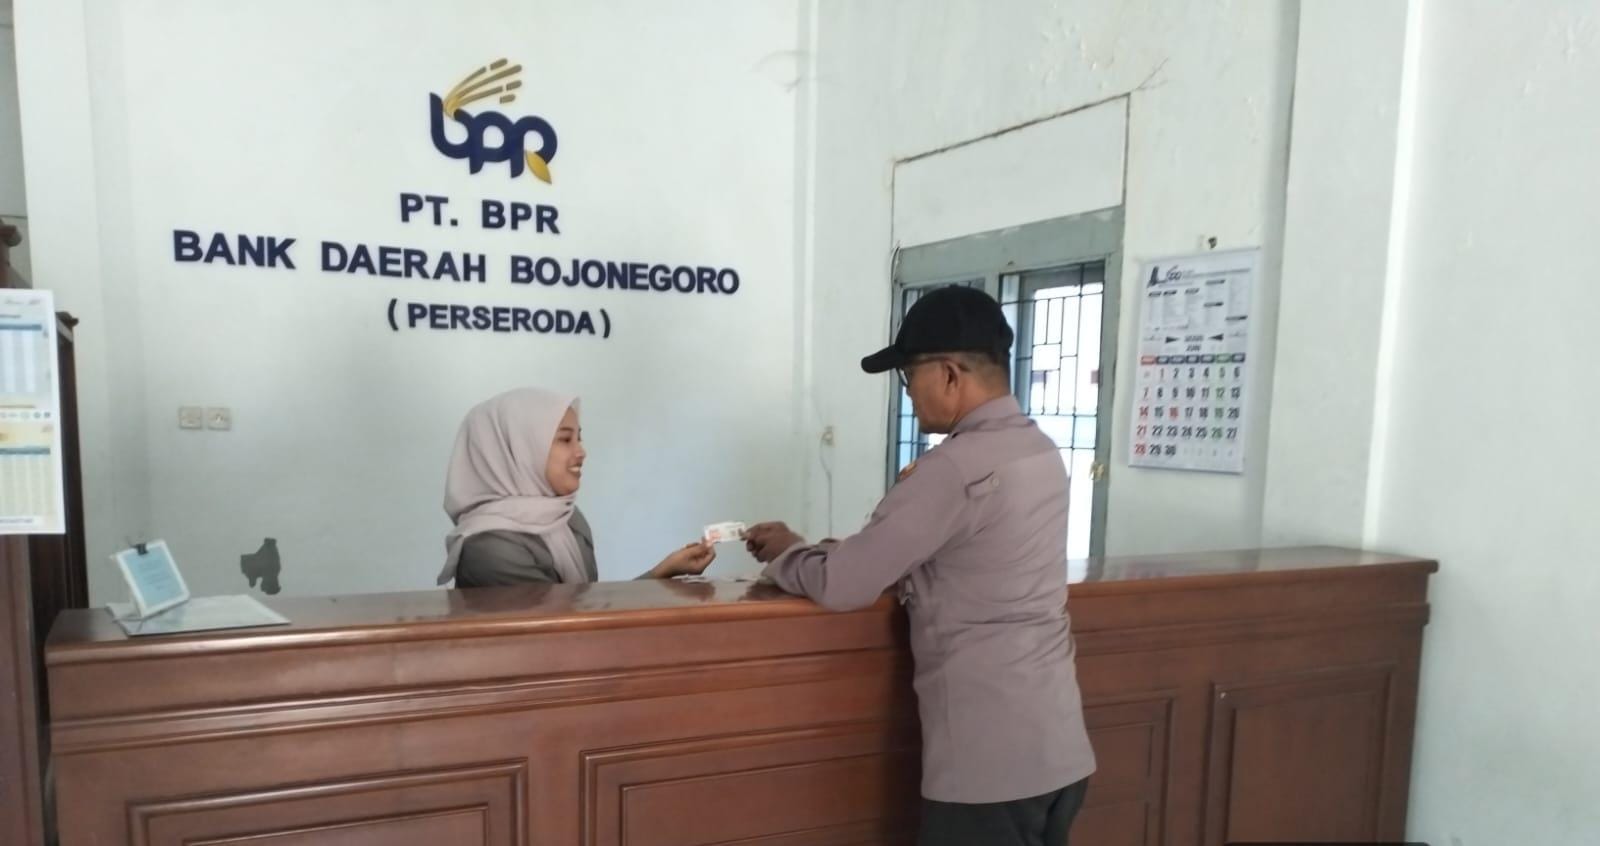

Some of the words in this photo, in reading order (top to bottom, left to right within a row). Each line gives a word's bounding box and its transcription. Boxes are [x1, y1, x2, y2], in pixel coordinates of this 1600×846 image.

[400, 194, 457, 226] PT.
[482, 200, 559, 234] BPR
[174, 230, 295, 269] BANK
[322, 242, 485, 282] DAERAH
[511, 256, 739, 294] BOJONEGORO
